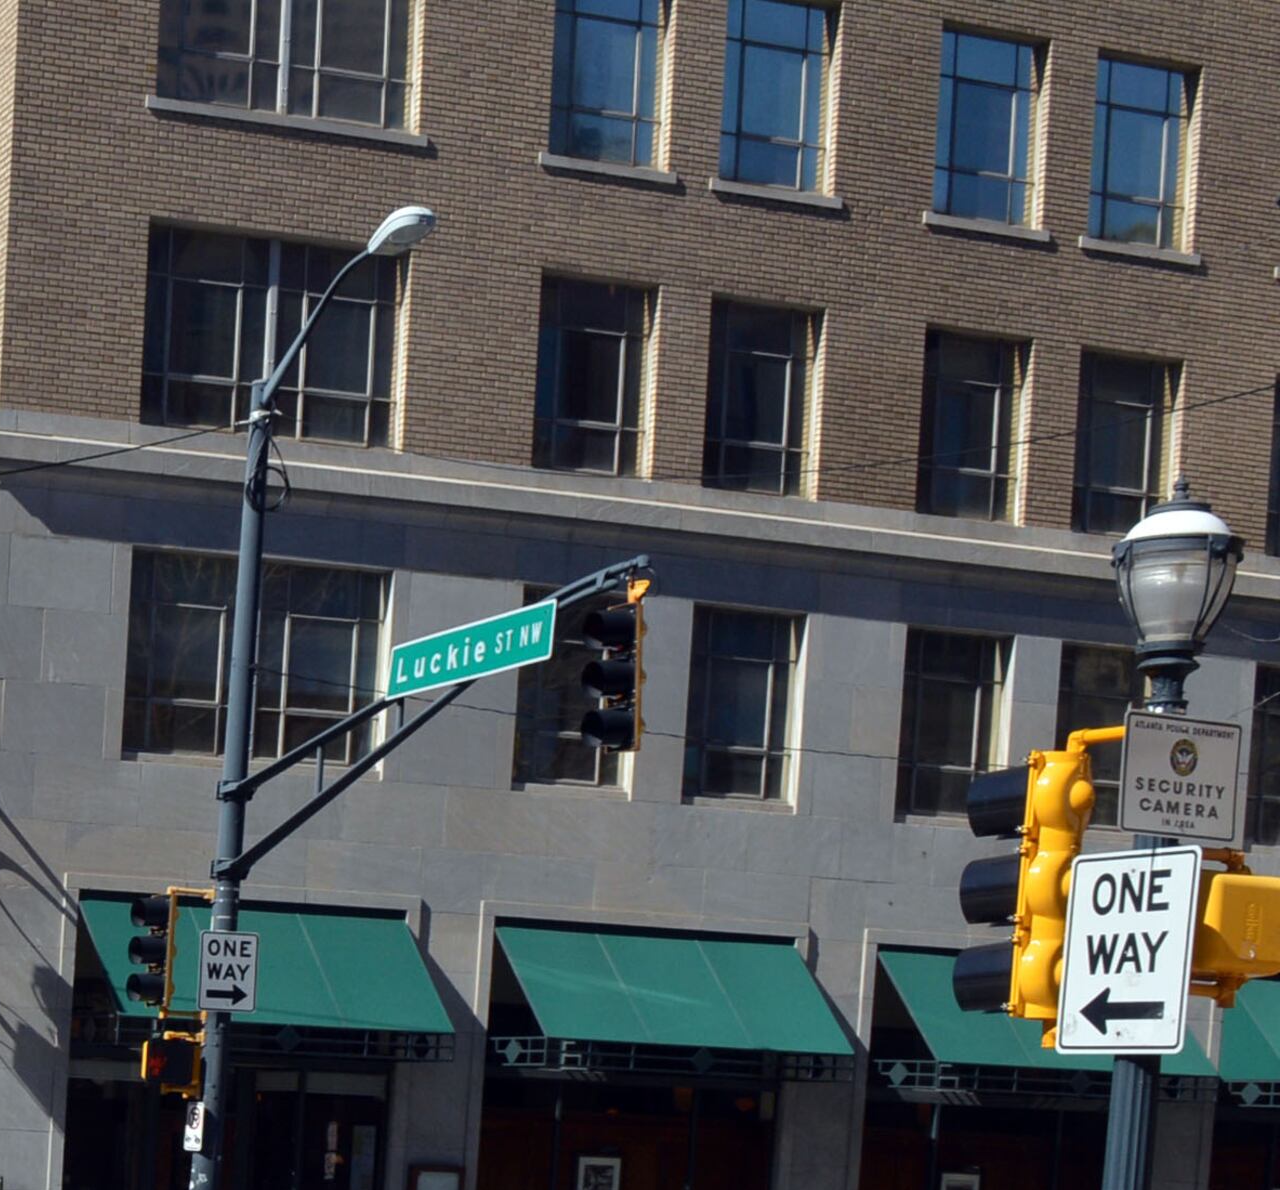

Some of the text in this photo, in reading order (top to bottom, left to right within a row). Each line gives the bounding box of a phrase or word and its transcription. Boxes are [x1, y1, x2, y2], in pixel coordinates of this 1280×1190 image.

[396, 621, 543, 683] Luckie ST NW
[1135, 720, 1163, 731] ATLANTA
[1192, 727, 1234, 739] DEPARTMENT
[1135, 776, 1225, 800] SECURITY
[1139, 798, 1219, 819] CAMERA
[1162, 818, 1170, 826] IN
[1093, 869, 1171, 915] ONE
[208, 939, 251, 957] ONE
[1087, 931, 1168, 975] WAY
[207, 963, 250, 981] WAY
